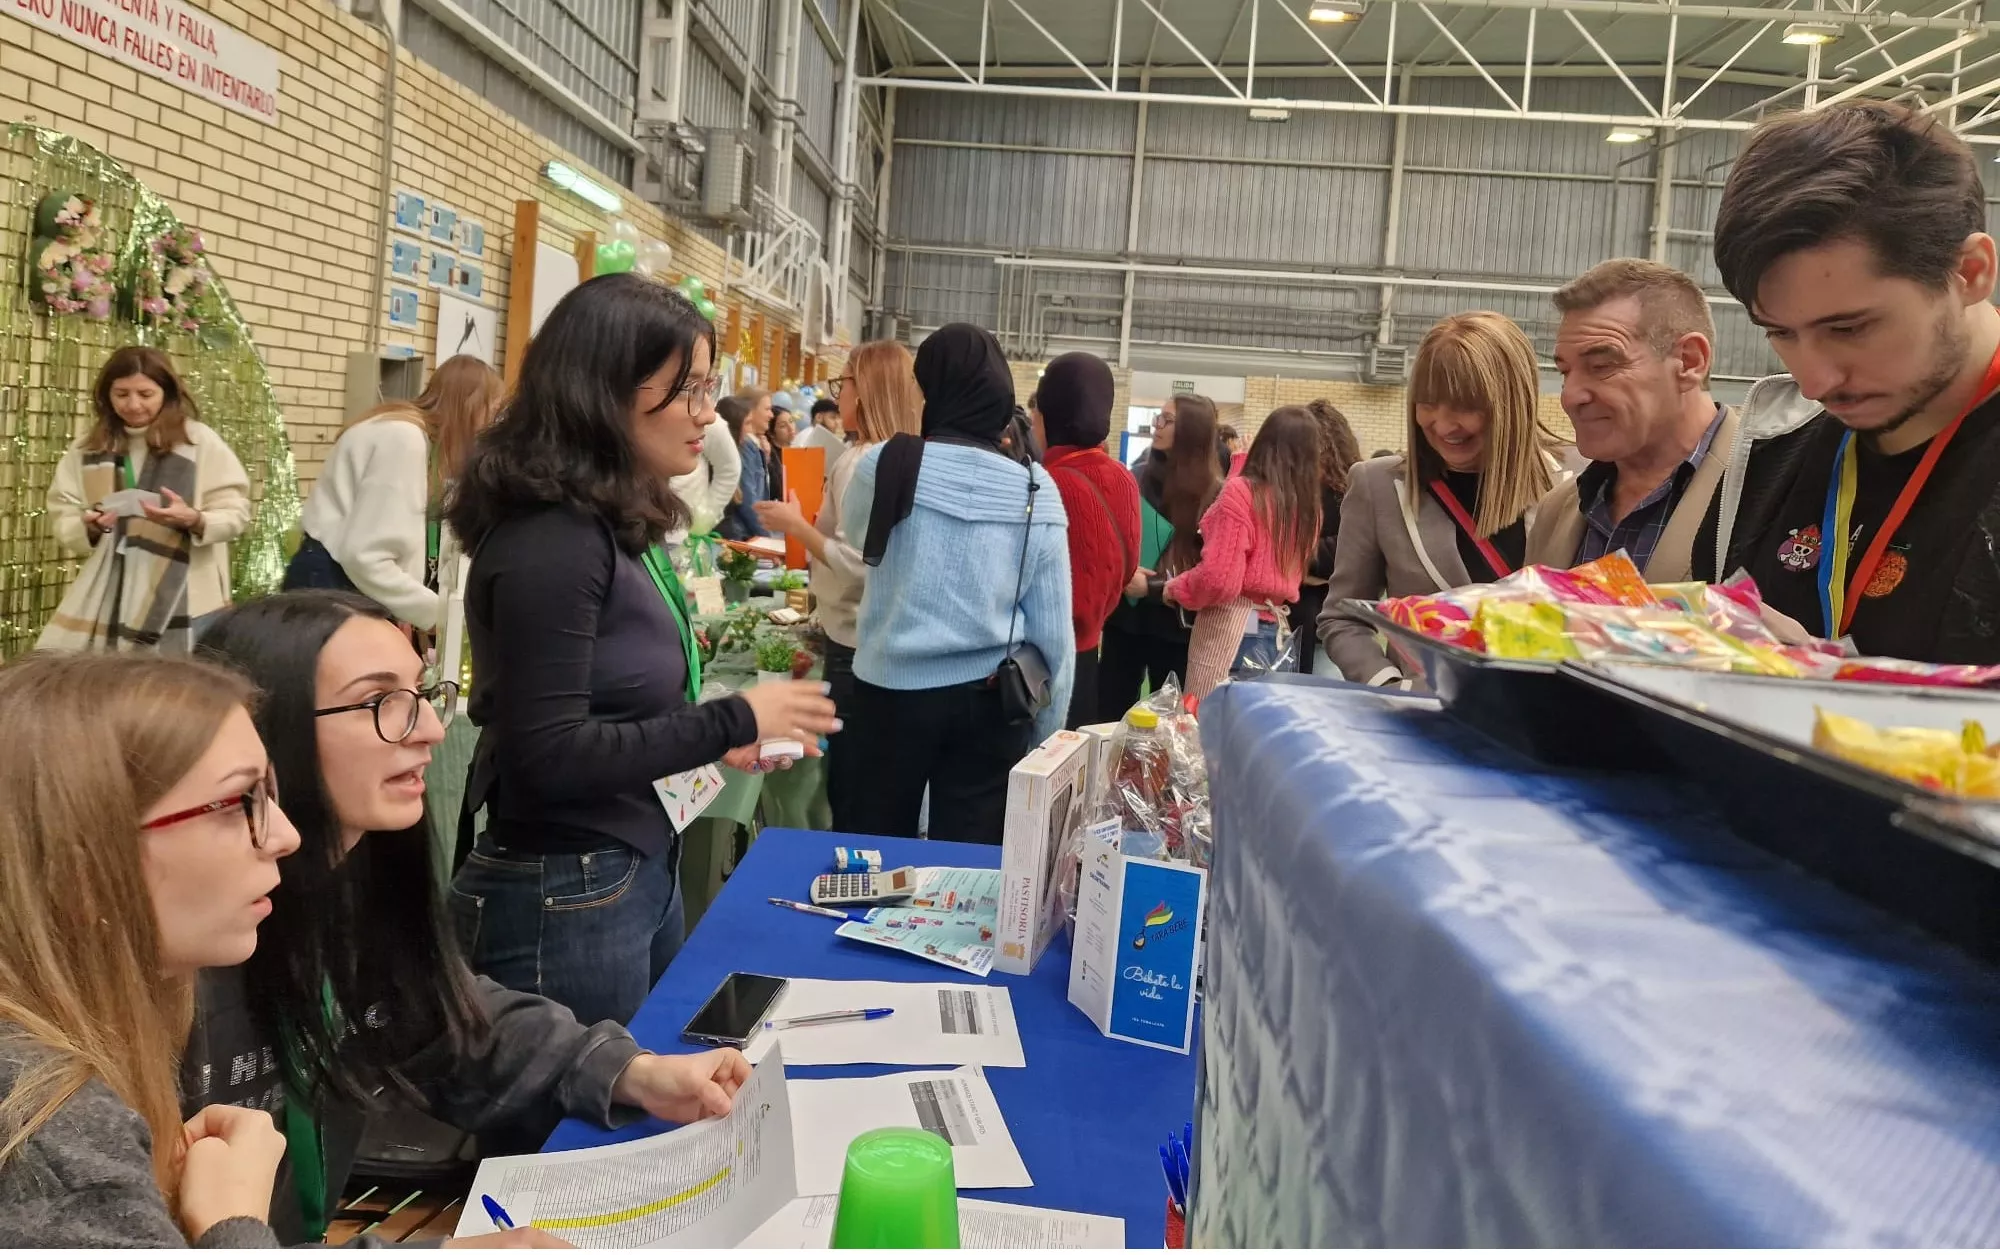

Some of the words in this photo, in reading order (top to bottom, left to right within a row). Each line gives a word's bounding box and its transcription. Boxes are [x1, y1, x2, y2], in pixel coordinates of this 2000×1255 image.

[165, 5, 174, 31] Y
[178, 12, 218, 59] FALLA,
[60, 0, 118, 48] NUNCA
[123, 27, 173, 71] FALLES
[178, 53, 197, 83] EN
[201, 63, 275, 116] INTENTARLO
[1139, 986, 1164, 1000] vida
[1171, 974, 1184, 990] la
